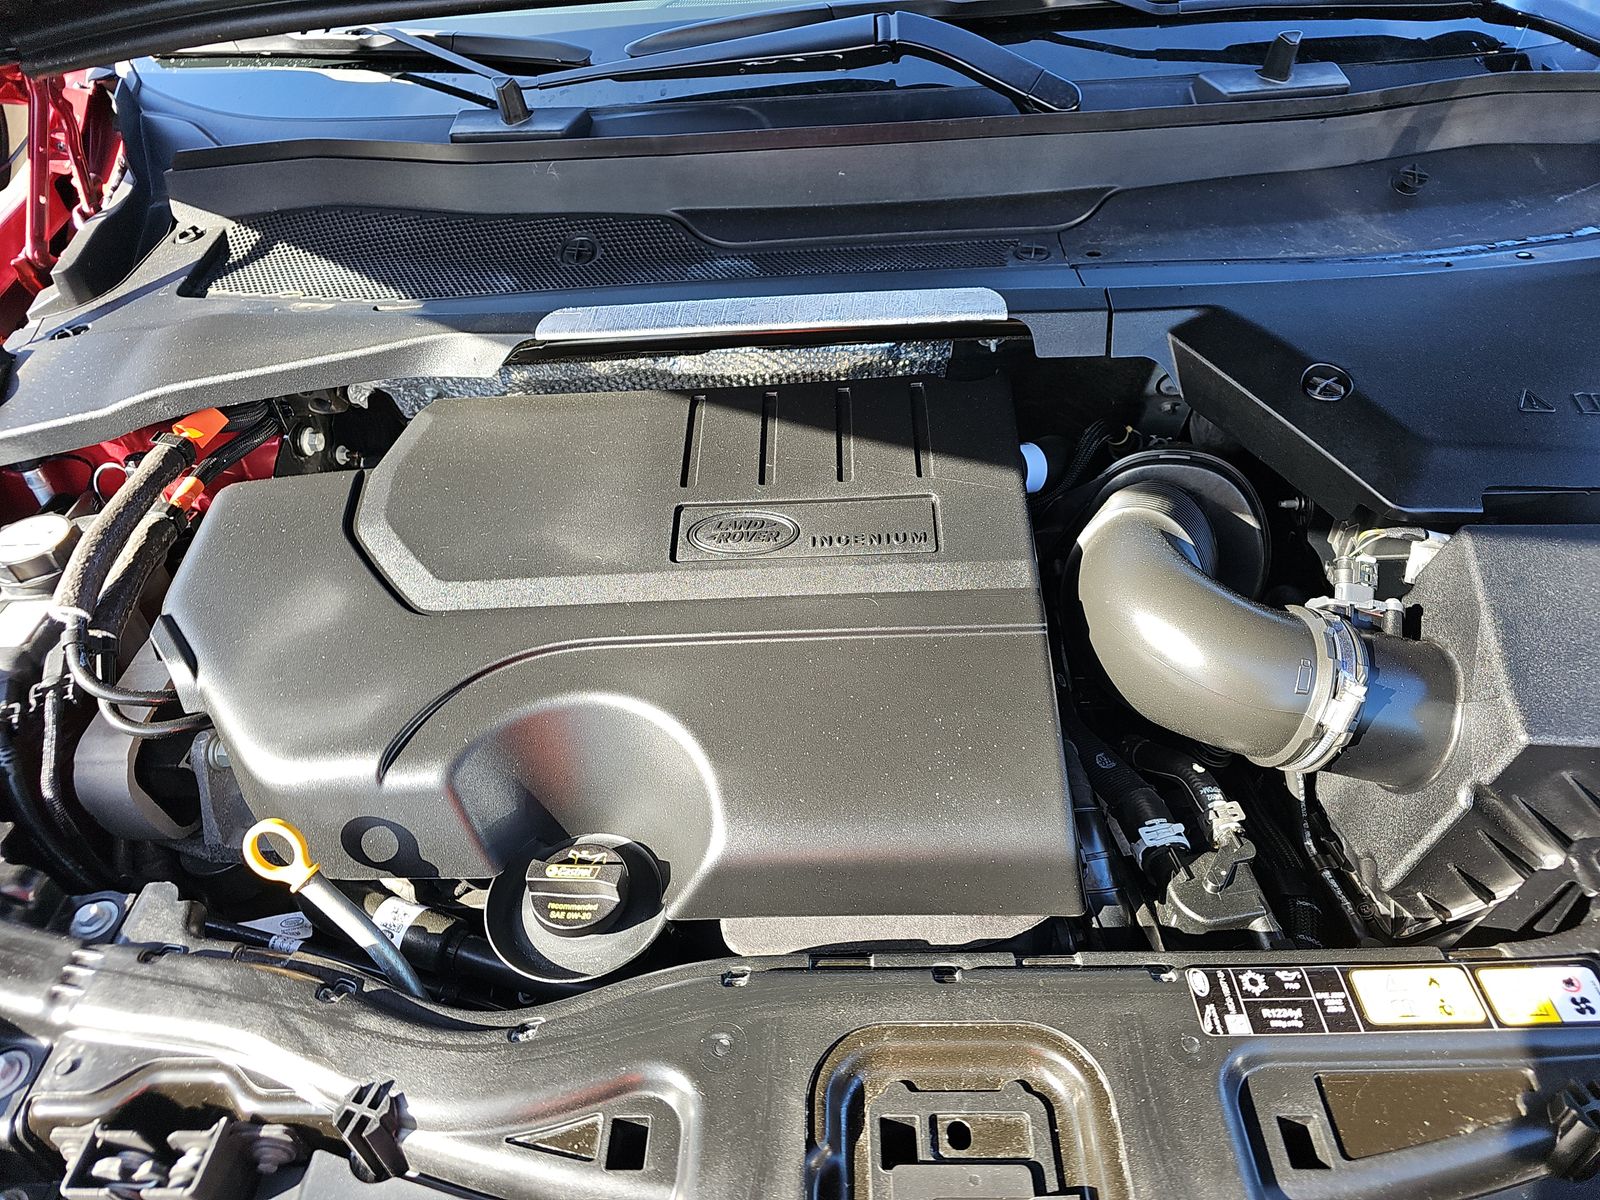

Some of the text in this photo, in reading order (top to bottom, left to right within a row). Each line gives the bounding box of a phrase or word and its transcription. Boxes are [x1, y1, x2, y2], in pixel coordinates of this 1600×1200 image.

[712, 519, 765, 531] LAND
[716, 530, 781, 544] ROVER
[810, 531, 928, 547] INGENIUM
[558, 865, 593, 877] Castrol
[547, 902, 599, 911] recommended
[549, 911, 566, 919] SAE
